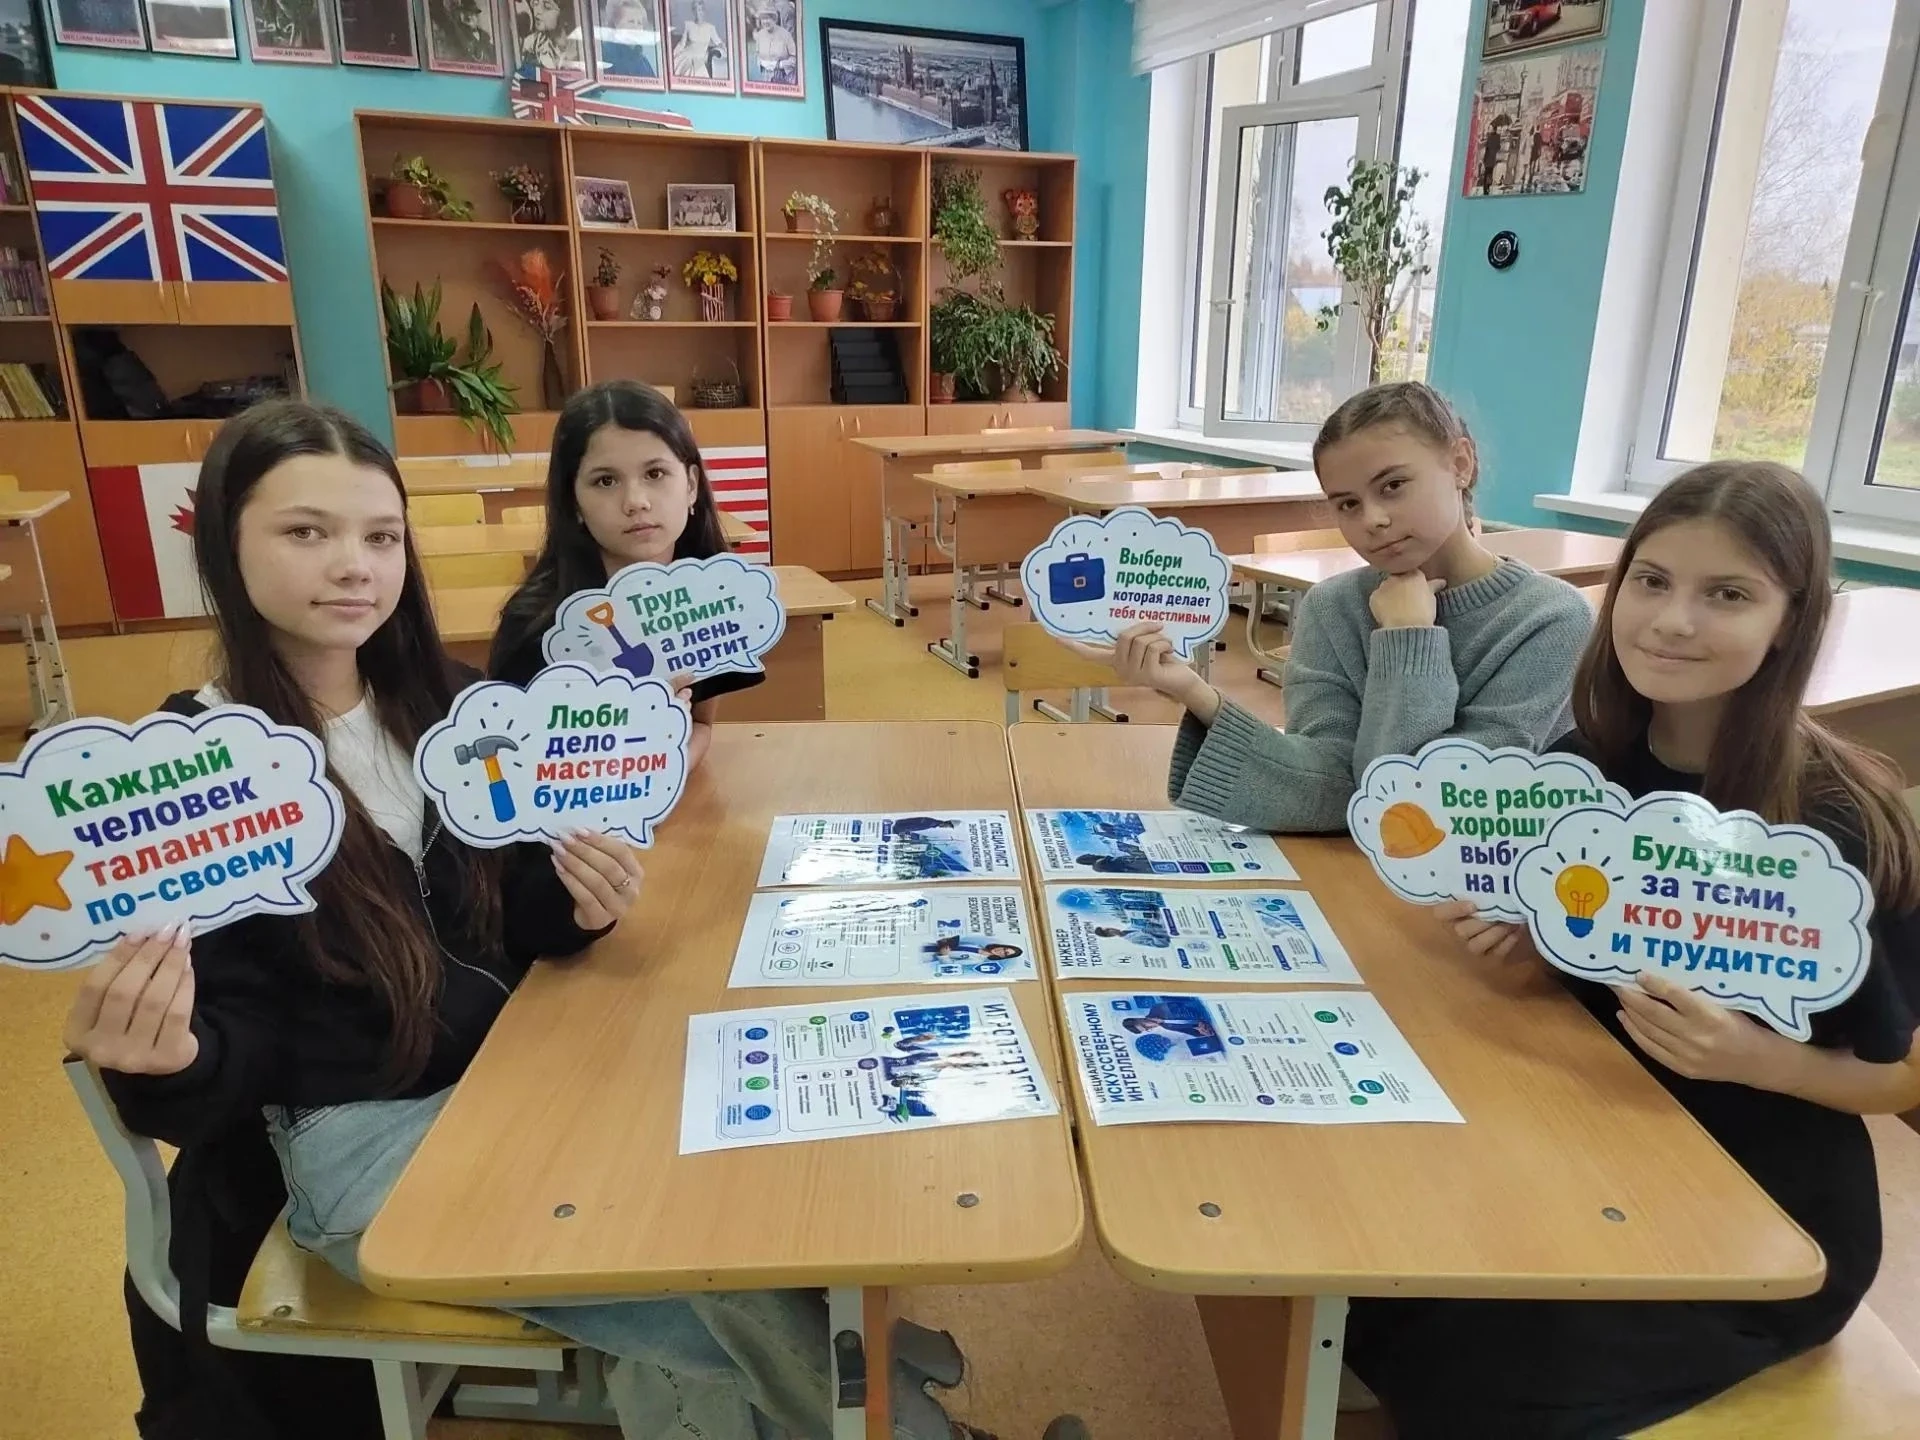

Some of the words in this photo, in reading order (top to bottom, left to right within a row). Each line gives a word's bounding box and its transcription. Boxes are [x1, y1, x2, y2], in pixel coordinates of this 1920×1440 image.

[1119, 547, 1182, 569] Выбери
[1113, 590, 1163, 607] которая
[1165, 593, 1211, 608] делает
[1115, 570, 1210, 592] профессию,
[626, 586, 692, 617] Труд
[640, 595, 745, 637] кормит,
[1109, 606, 1135, 620] тебя
[1138, 609, 1211, 625] счастливым
[660, 637, 676, 653] а
[682, 619, 741, 648] лень
[666, 634, 749, 673] портит
[547, 703, 629, 730] Люби
[545, 731, 617, 759] дело
[45, 737, 234, 817] Каждый
[536, 752, 668, 781] мастером
[73, 776, 259, 848] человек
[533, 774, 652, 813] будешь!
[1440, 782, 1488, 809] Все
[1496, 781, 1604, 815] работы
[84, 801, 304, 887] талантлив
[990, 822, 1009, 867] СПЕЦИАЛИСТ
[1632, 834, 1798, 879] Будущее
[84, 837, 294, 925] по-своему
[1465, 873, 1495, 894] на
[1640, 874, 1679, 899] за
[1692, 880, 1796, 918] теми,
[1004, 896, 1021, 935] СПЕЦИАЛИСТ
[1067, 912, 1086, 956] ВОДОРОДНЫМ
[1623, 903, 1682, 930] кто
[1692, 912, 1821, 950] учится
[1056, 928, 1074, 967] ИНЖЕНЕР
[1076, 957, 1089, 968] ПО
[1083, 921, 1103, 967] ТЕХНОЛОГИЯМ
[1611, 933, 1632, 955] и
[1643, 937, 1818, 982] трудится
[1078, 1035, 1090, 1046] ПО
[1083, 1002, 1126, 1103] ИСКУССТВЕННОМУ
[1082, 1048, 1107, 1103] СПЕЦИАЛИСТ
[1109, 1033, 1145, 1101] ИНТЕЛЛЕКТУ
